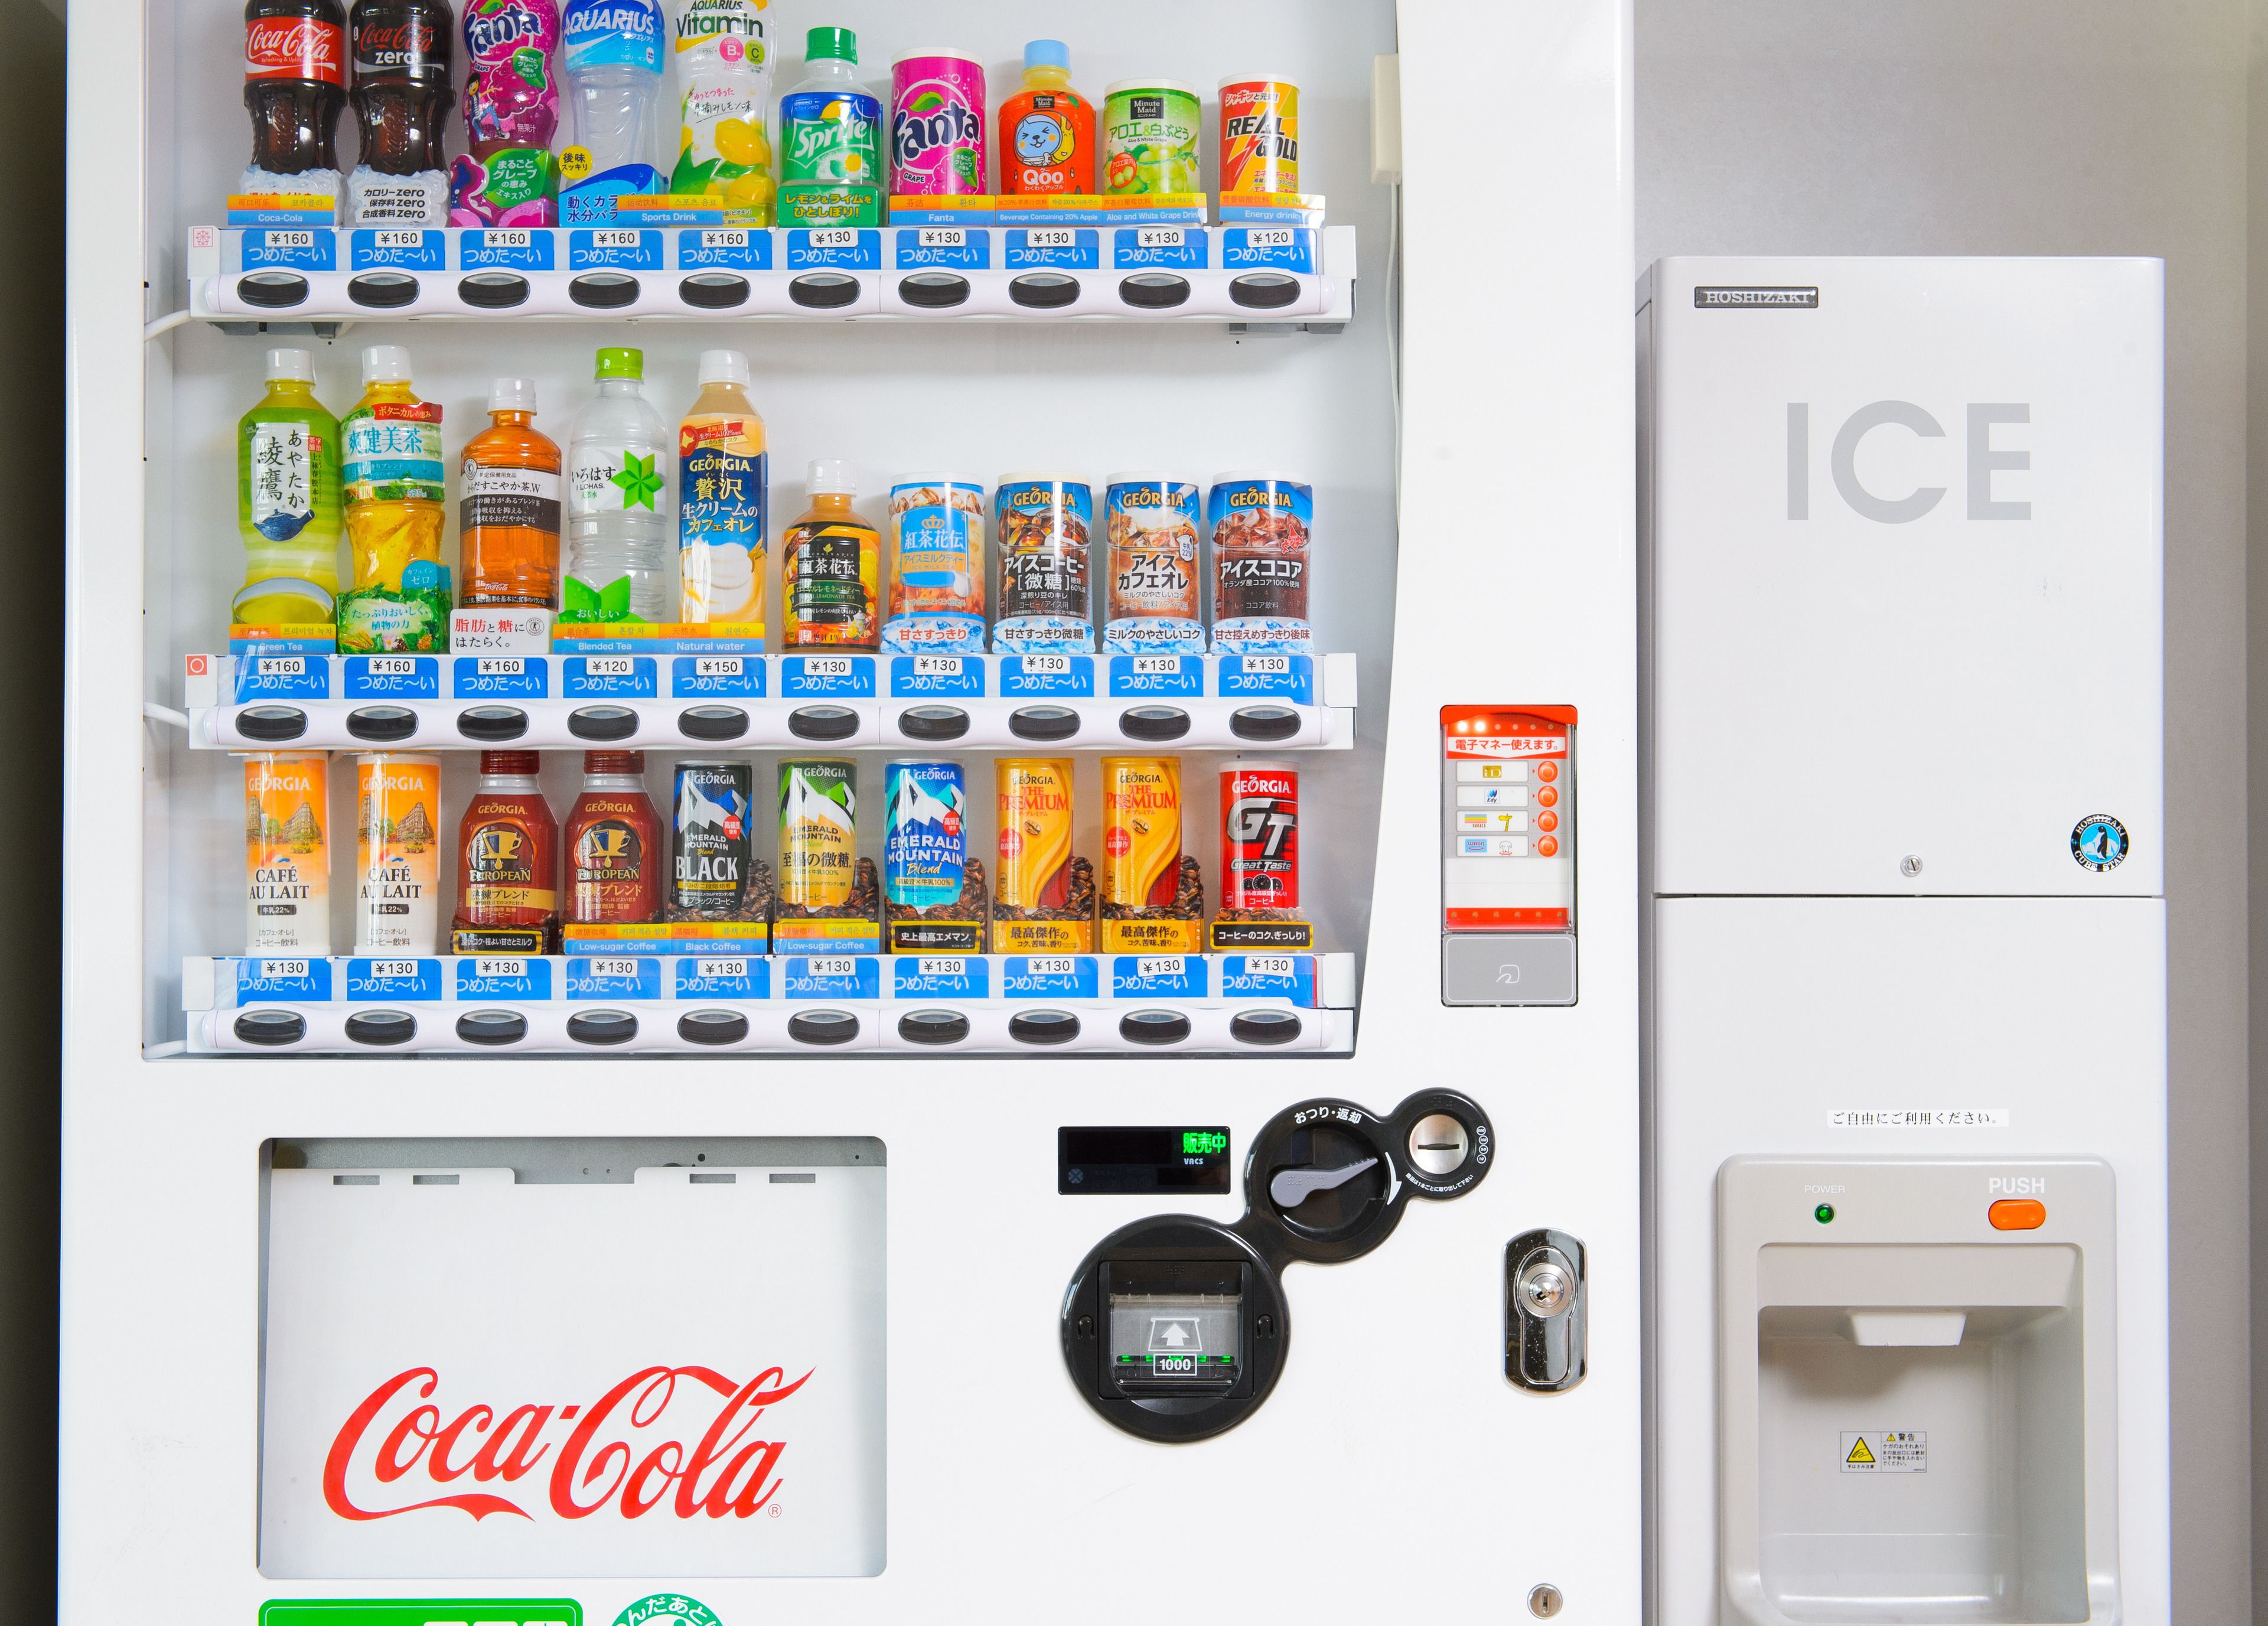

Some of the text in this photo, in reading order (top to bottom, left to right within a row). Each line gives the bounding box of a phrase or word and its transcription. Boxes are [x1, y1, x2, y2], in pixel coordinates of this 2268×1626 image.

[565, 8, 654, 36] AQUARIUS
[676, 13, 763, 38] Vitamin
[248, 24, 334, 59] Coca-Cola
[360, 22, 436, 52] Coca-Cola
[1227, 109, 1285, 138] REAL
[797, 113, 868, 158] Sprite
[892, 100, 980, 170] Fanta
[1109, 122, 1189, 143] アロエ&白ぶどう
[1256, 136, 1297, 161] GOLD
[497, 159, 534, 169] まるごと
[563, 153, 585, 163] 後味
[493, 169, 537, 180] グレープ
[904, 172, 925, 183] GRAPE
[1023, 170, 1064, 185] Qoo
[496, 188, 532, 200] エキス入り
[786, 194, 872, 204] レモン&ライムを
[259, 214, 302, 222] Coca-Cola
[642, 213, 671, 223] Sports
[794, 207, 859, 217] ひとしぼり!
[928, 213, 954, 221] Fanta
[1030, 213, 1064, 221] Containing
[1245, 210, 1274, 219] Energy
[272, 234, 308, 244] ¥160
[382, 233, 417, 244] ¥160
[489, 233, 525, 244] ¥160
[599, 233, 634, 244] ¥160
[707, 234, 743, 244] ¥160
[816, 232, 850, 244] ¥130
[926, 233, 960, 243] ¥130
[1034, 233, 1068, 243] ¥130
[1145, 233, 1178, 243] ¥130
[1254, 233, 1288, 243] ¥120
[1705, 291, 1811, 303] HOSHIZAKI
[348, 426, 423, 458] 爽健美茶
[689, 453, 751, 472] GEORGIA
[1787, 400, 2031, 524] ICE
[287, 429, 305, 509] あやたか
[571, 466, 616, 483] いろはす
[695, 477, 747, 501] 贅沢
[682, 502, 758, 520] 生クリームの
[686, 518, 755, 535] カフェオレ
[904, 530, 964, 550] 紅茶花伝
[904, 553, 964, 565] アイスミルクティー
[1004, 555, 1084, 575] アイスコーヒー
[1132, 554, 1176, 572] アイス
[1220, 559, 1302, 580] アイスココア
[1119, 572, 1188, 591] カフェオレ
[1224, 579, 1300, 588] オランダ産ココア100%使用
[576, 608, 620, 619] おいしい
[372, 619, 410, 630] 植物の力
[454, 618, 524, 633] 脂肪と糖に
[899, 628, 967, 641] 甘さすっきり
[1005, 628, 1084, 640] 甘さすっきり微糖
[1109, 629, 1201, 640] ミルクのやさしいコク
[1214, 628, 1311, 640] 甘さ控えめすっきり後味
[578, 642, 614, 650] Blended
[676, 642, 713, 651] Natural
[263, 662, 299, 672] ¥160
[374, 661, 410, 672] ¥160
[483, 662, 519, 672] ¥160
[593, 662, 627, 672] ¥120
[703, 662, 737, 672] ¥150
[812, 662, 845, 672] ¥130
[921, 659, 956, 671] ¥130
[1028, 657, 1063, 669] ¥130
[1139, 660, 1174, 670] ¥130
[1248, 659, 1283, 669] ¥130
[1455, 738, 1558, 751] 電子マネー使えます。
[804, 764, 847, 778] GEORGIA
[915, 768, 956, 780] GEORGIA
[1129, 784, 1151, 794] THE
[1232, 775, 1291, 794] GEORGIA
[1022, 787, 1044, 795] THE
[585, 800, 634, 813] GEORGIA
[1106, 791, 1177, 810] PREMIUM
[478, 802, 526, 815] GEORGIA
[1227, 797, 1298, 856] GT
[2075, 815, 2127, 837] HOSHIZAKI
[891, 835, 960, 851] EMERALD
[888, 849, 963, 867] MOUNTAIN
[2074, 851, 2126, 872] CUBE STAR
[256, 866, 298, 882] CAFÉ
[676, 856, 738, 881] BLACK
[249, 885, 309, 899] AU LAIT
[1218, 931, 1306, 940] コーヒーのコク、ぎっしり!
[579, 942, 656, 952] Low-sugar Coffee
[686, 942, 741, 950] Black Coffee
[788, 941, 865, 952] Low-sugar Coffee
[268, 963, 303, 973] ¥130
[376, 963, 412, 974] ¥130
[483, 962, 519, 973] ¥130
[597, 962, 632, 973] ¥130
[706, 963, 742, 974] ¥130
[814, 961, 850, 971] ¥130
[925, 962, 960, 972] ¥130
[1034, 961, 1069, 971] ¥130
[1144, 960, 1179, 973] ¥130
[1252, 959, 1288, 970] ¥130
[1295, 1106, 1363, 1125] おつり・返却
[1833, 1112, 1997, 1125] ご自由にご利用ください。
[1183, 1132, 1227, 1153] 販売中
[1804, 1185, 1846, 1194] POWER
[1989, 1177, 2045, 1194] PUSH
[1159, 1358, 1191, 1370] 1000
[1898, 1433, 1915, 1441] 警告
[323, 1366, 816, 1522] Coca-Cola
